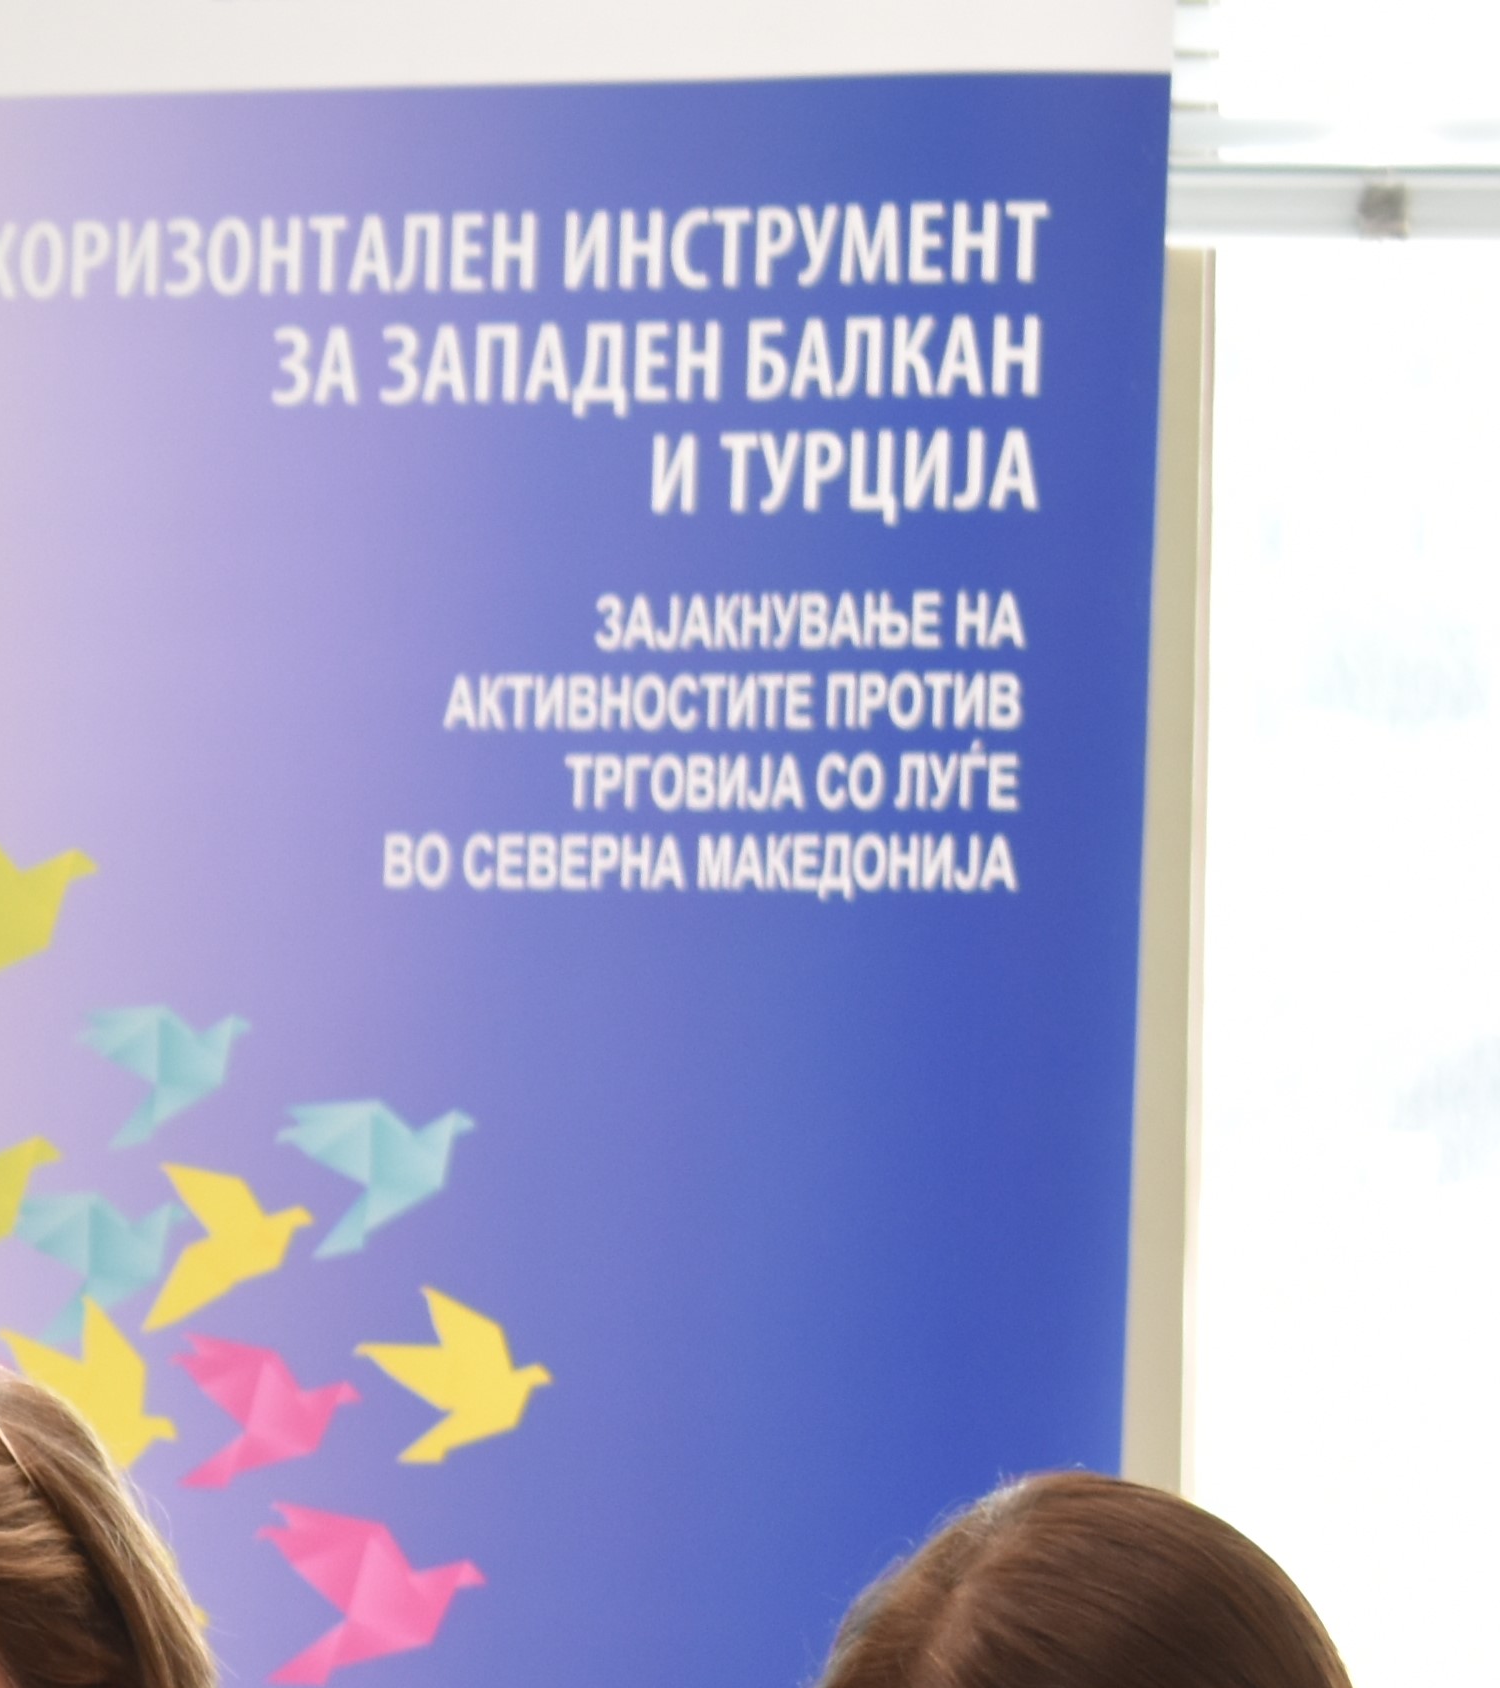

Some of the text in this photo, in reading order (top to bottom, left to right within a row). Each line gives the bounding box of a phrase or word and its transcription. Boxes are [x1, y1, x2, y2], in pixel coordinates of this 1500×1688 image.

[563, 201, 1049, 289] ИНСТРУМЕНТ
[272, 315, 1043, 417] ЗА ЗАПАДЕН БАЛКАН
[650, 428, 1039, 525] И ТУРЦИЈА
[594, 591, 1025, 651] ЗАЈАКНУВАЊЕ НА
[443, 672, 1022, 731] АКТИВНОСТИТЕ ПРОТИВ
[565, 738, 1019, 811] ТРГОВИЈА СО ЛУЃЕ
[383, 831, 1017, 900] ВО СЕВЕРНА МАКЕДОНИЈА
